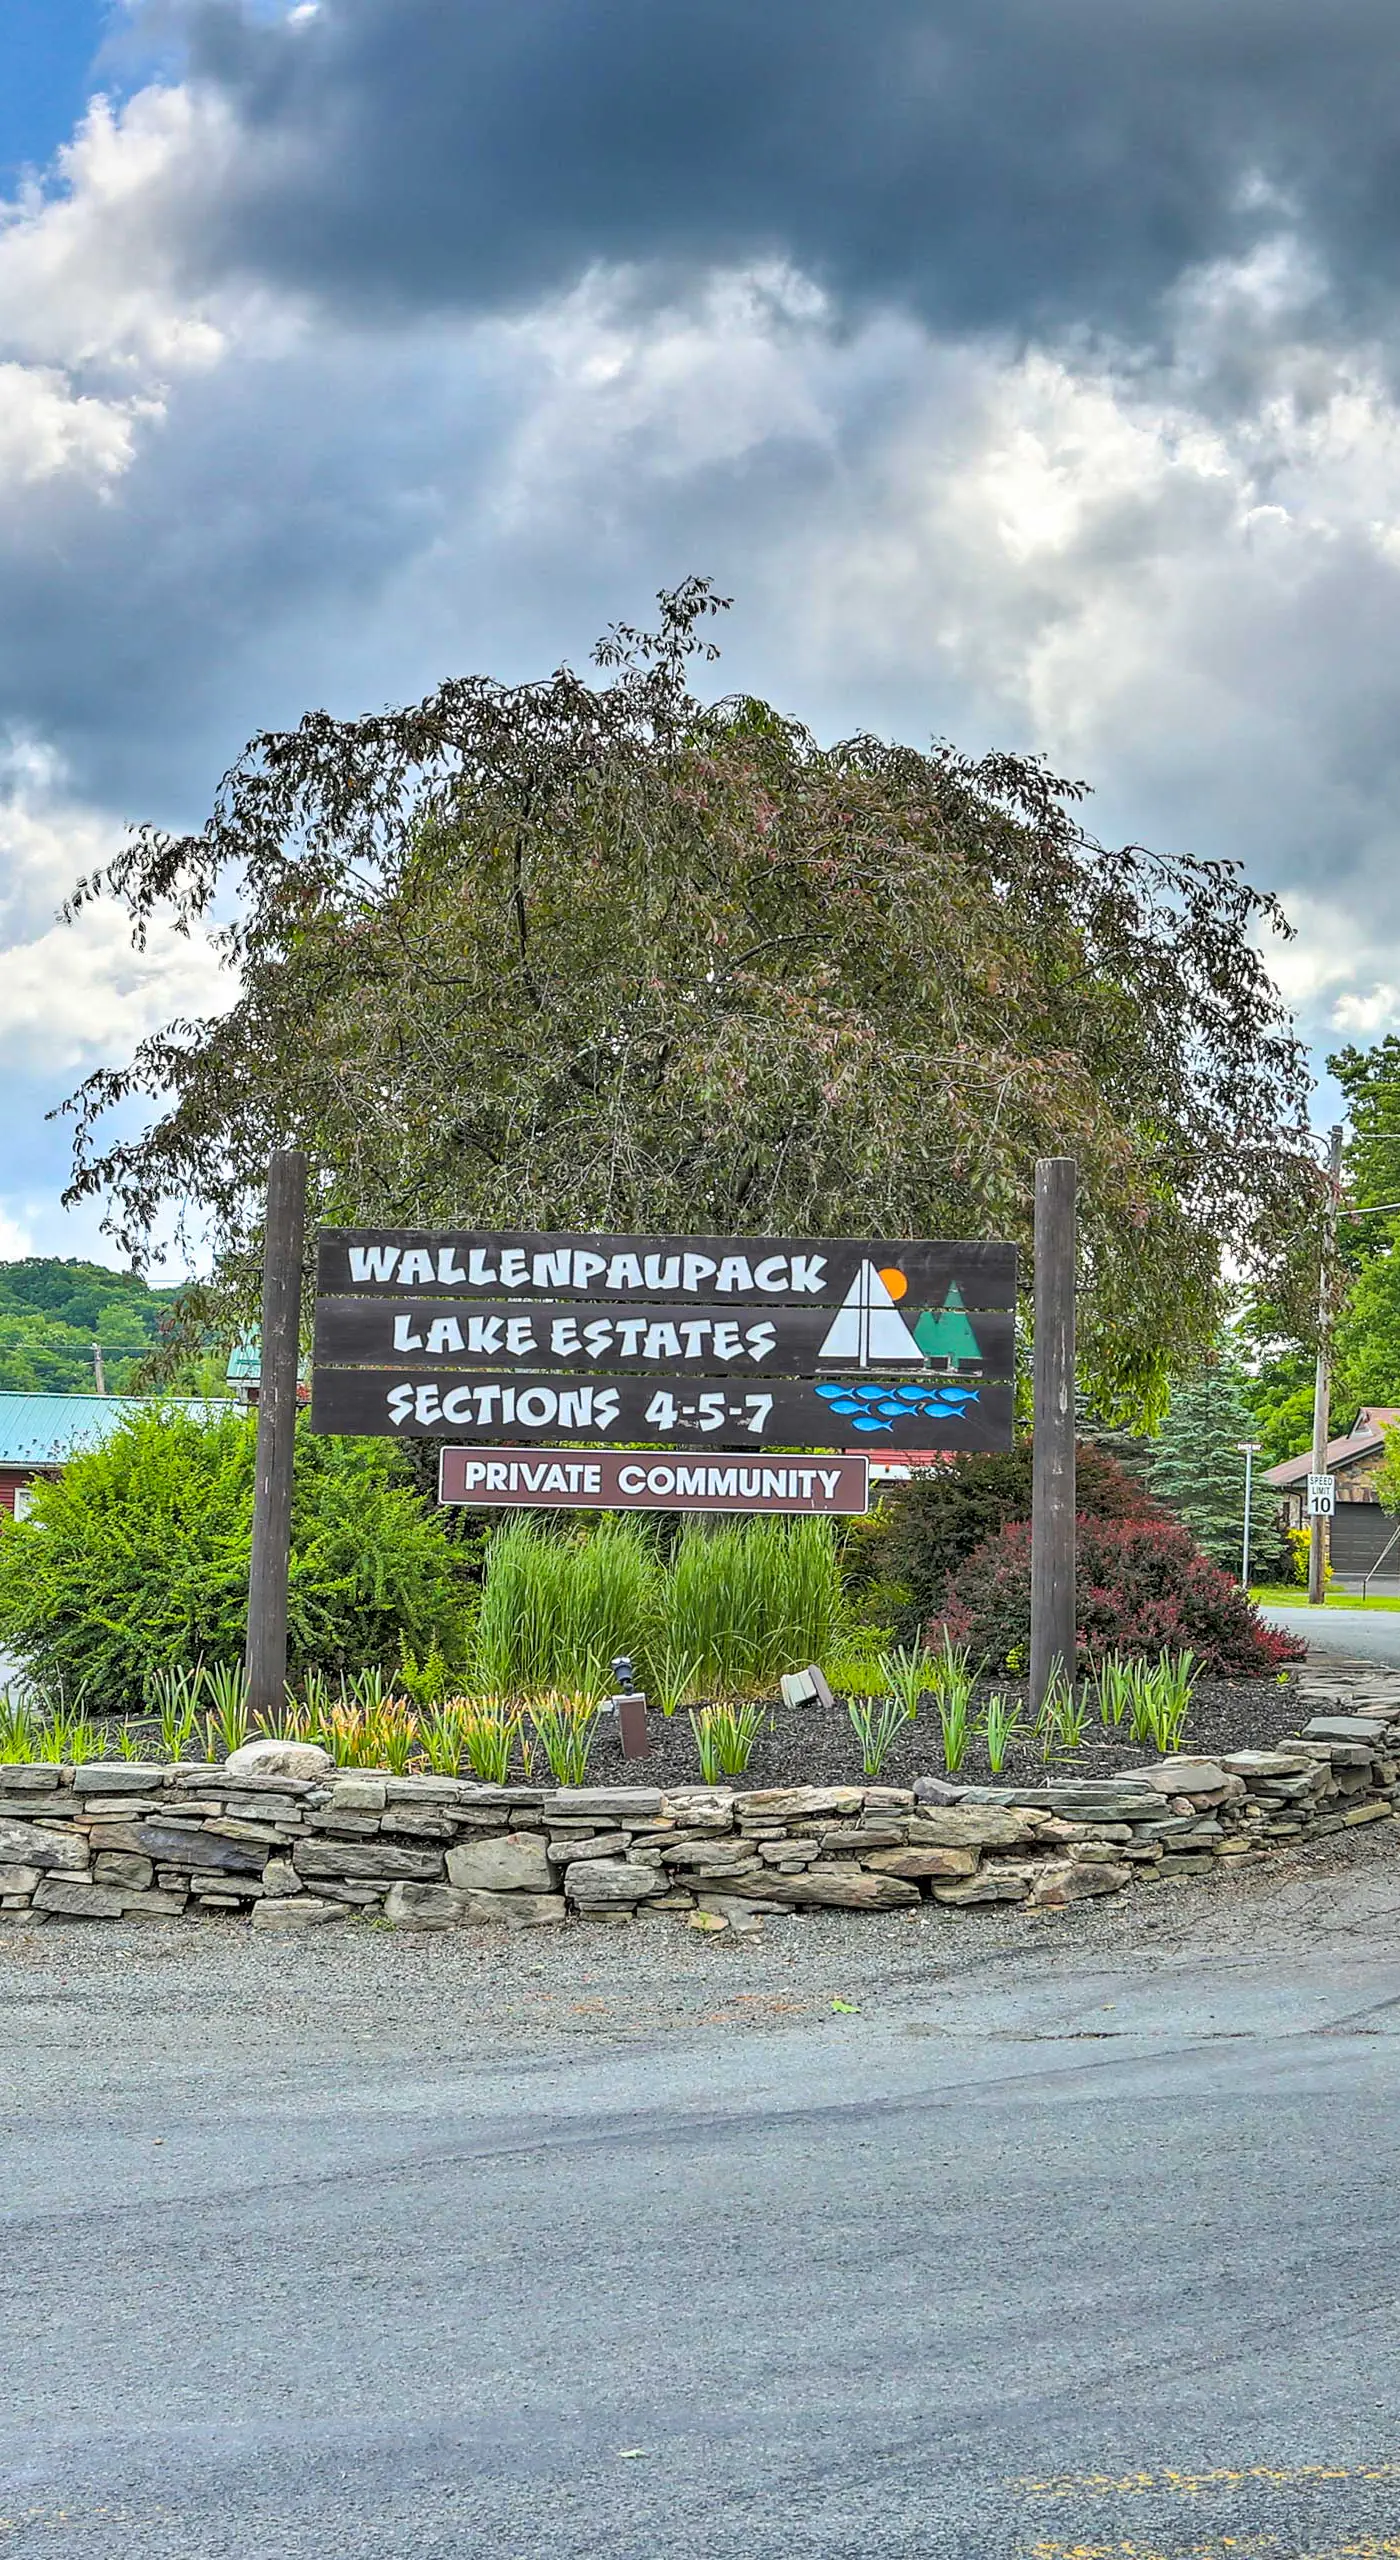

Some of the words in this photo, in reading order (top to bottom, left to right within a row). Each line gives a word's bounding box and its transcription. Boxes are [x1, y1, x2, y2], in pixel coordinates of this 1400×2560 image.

[348, 1245, 828, 1294] WALLENPAUPACK
[393, 1314, 538, 1356] LAKE
[550, 1317, 776, 1362] ESTATES
[386, 1383, 620, 1431] SECTIONS
[644, 1390, 773, 1434] 4-5-7
[465, 1461, 601, 1493] PRIVATE
[618, 1465, 842, 1499] COMMUNITY
[1310, 1476, 1333, 1486] SPEED
[1312, 1486, 1331, 1495] LIMIT
[1311, 1496, 1331, 1513] 10
